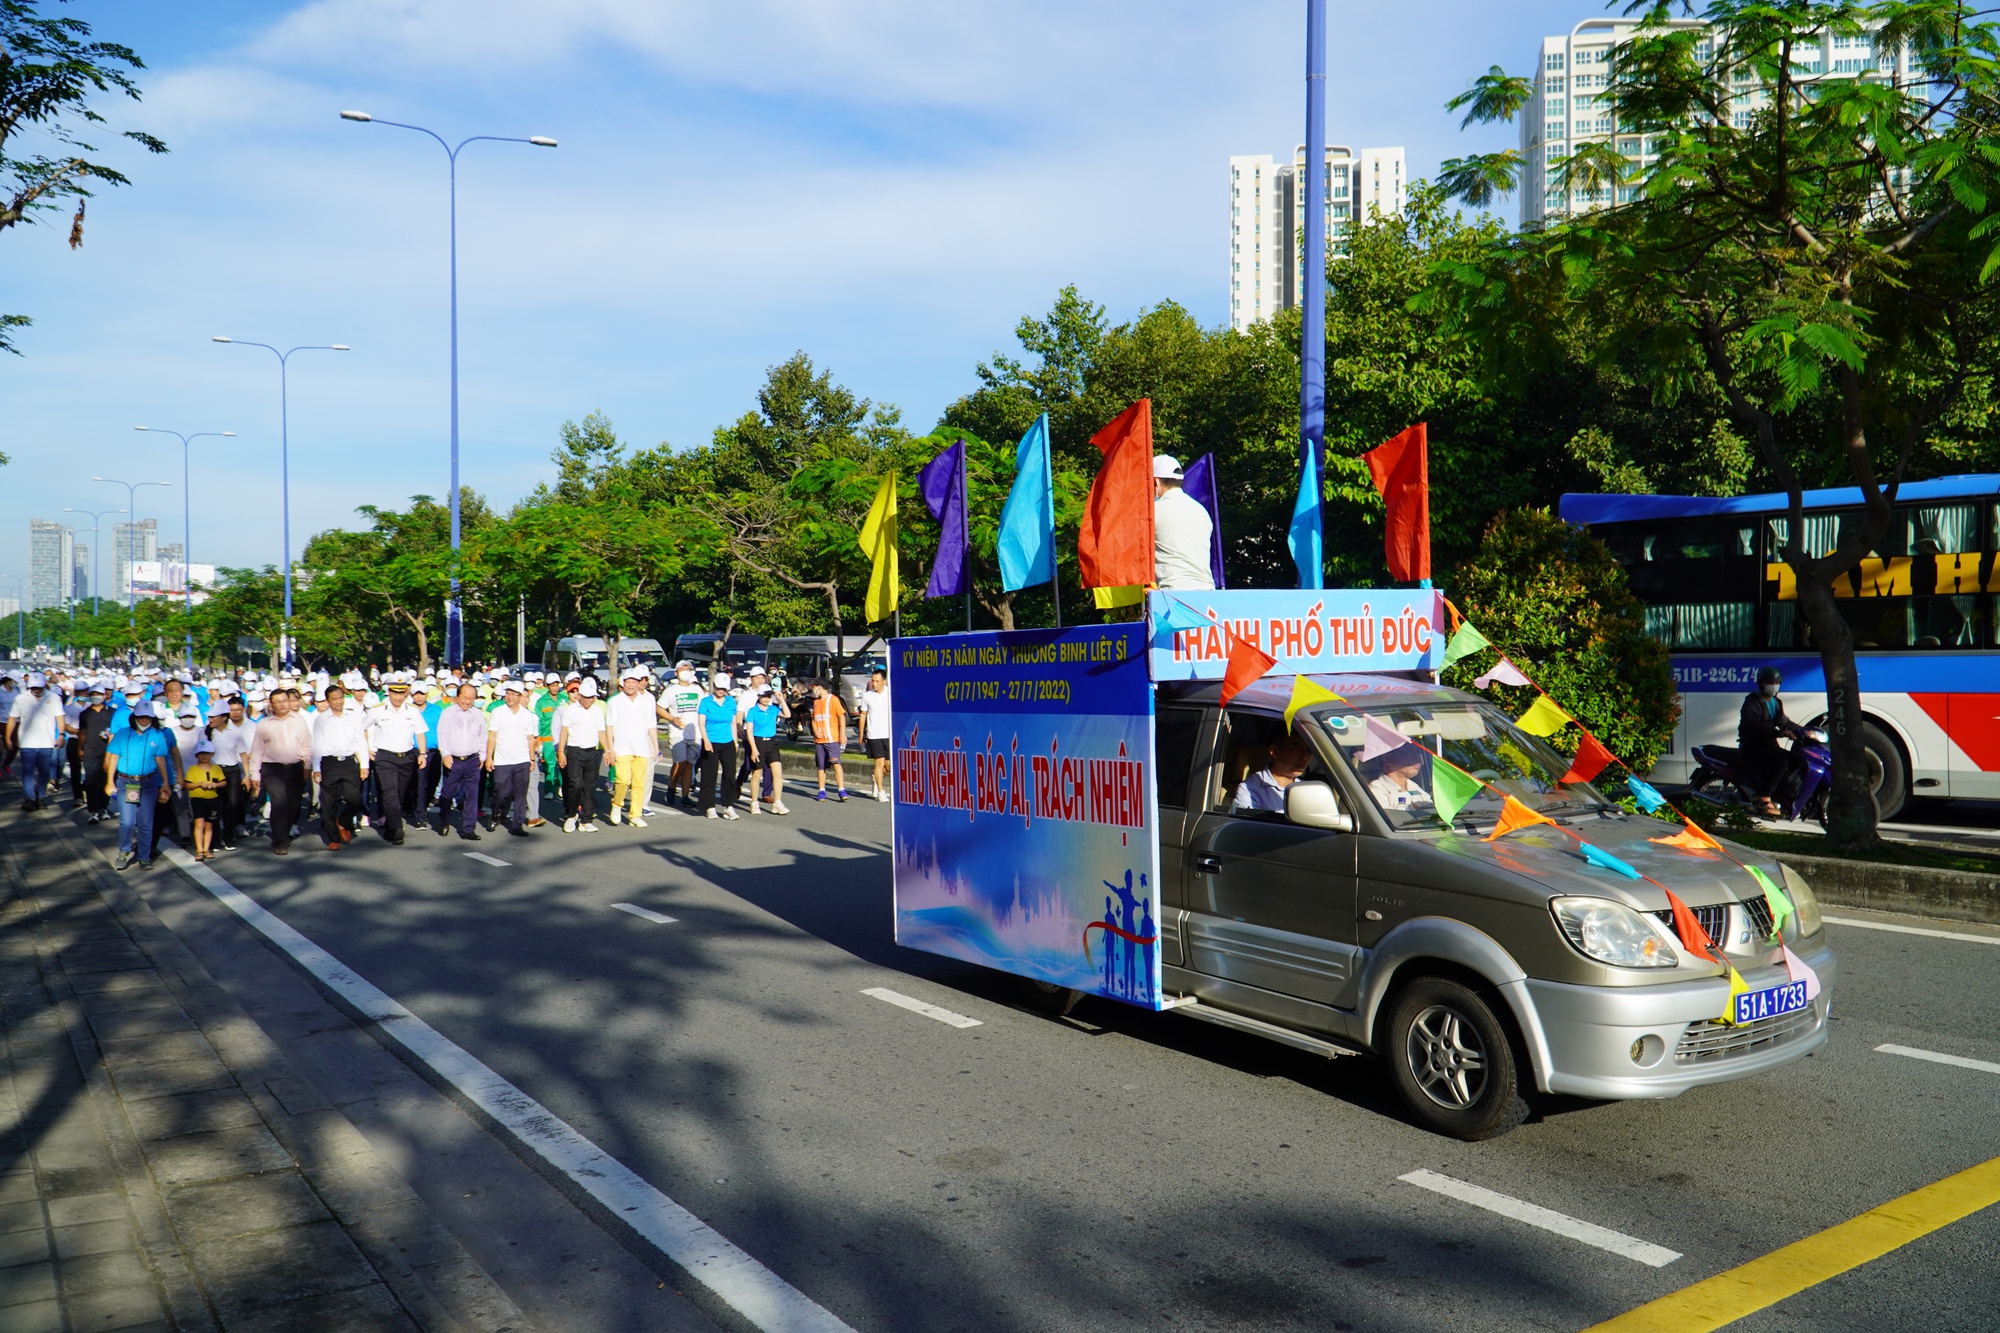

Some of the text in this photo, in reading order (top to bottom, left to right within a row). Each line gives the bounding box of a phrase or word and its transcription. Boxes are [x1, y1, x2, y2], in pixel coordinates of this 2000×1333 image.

[1934, 551, 2000, 595] H
[1270, 600, 1324, 658] PHỐ
[1330, 604, 1374, 657] THỦ
[1380, 603, 1431, 655] ĐỨC
[903, 635, 1128, 672] KỶ NIỆM 75 NĂM NGÀY THƯƠNG BINH LIỆT SĨ
[945, 681, 1000, 705] (27/7/1947
[1008, 680, 1071, 705] 27/7/2022)
[899, 721, 1145, 847] HIẾU NGHĨA, BÁC ÁI, TRÁCH NHIỆM
